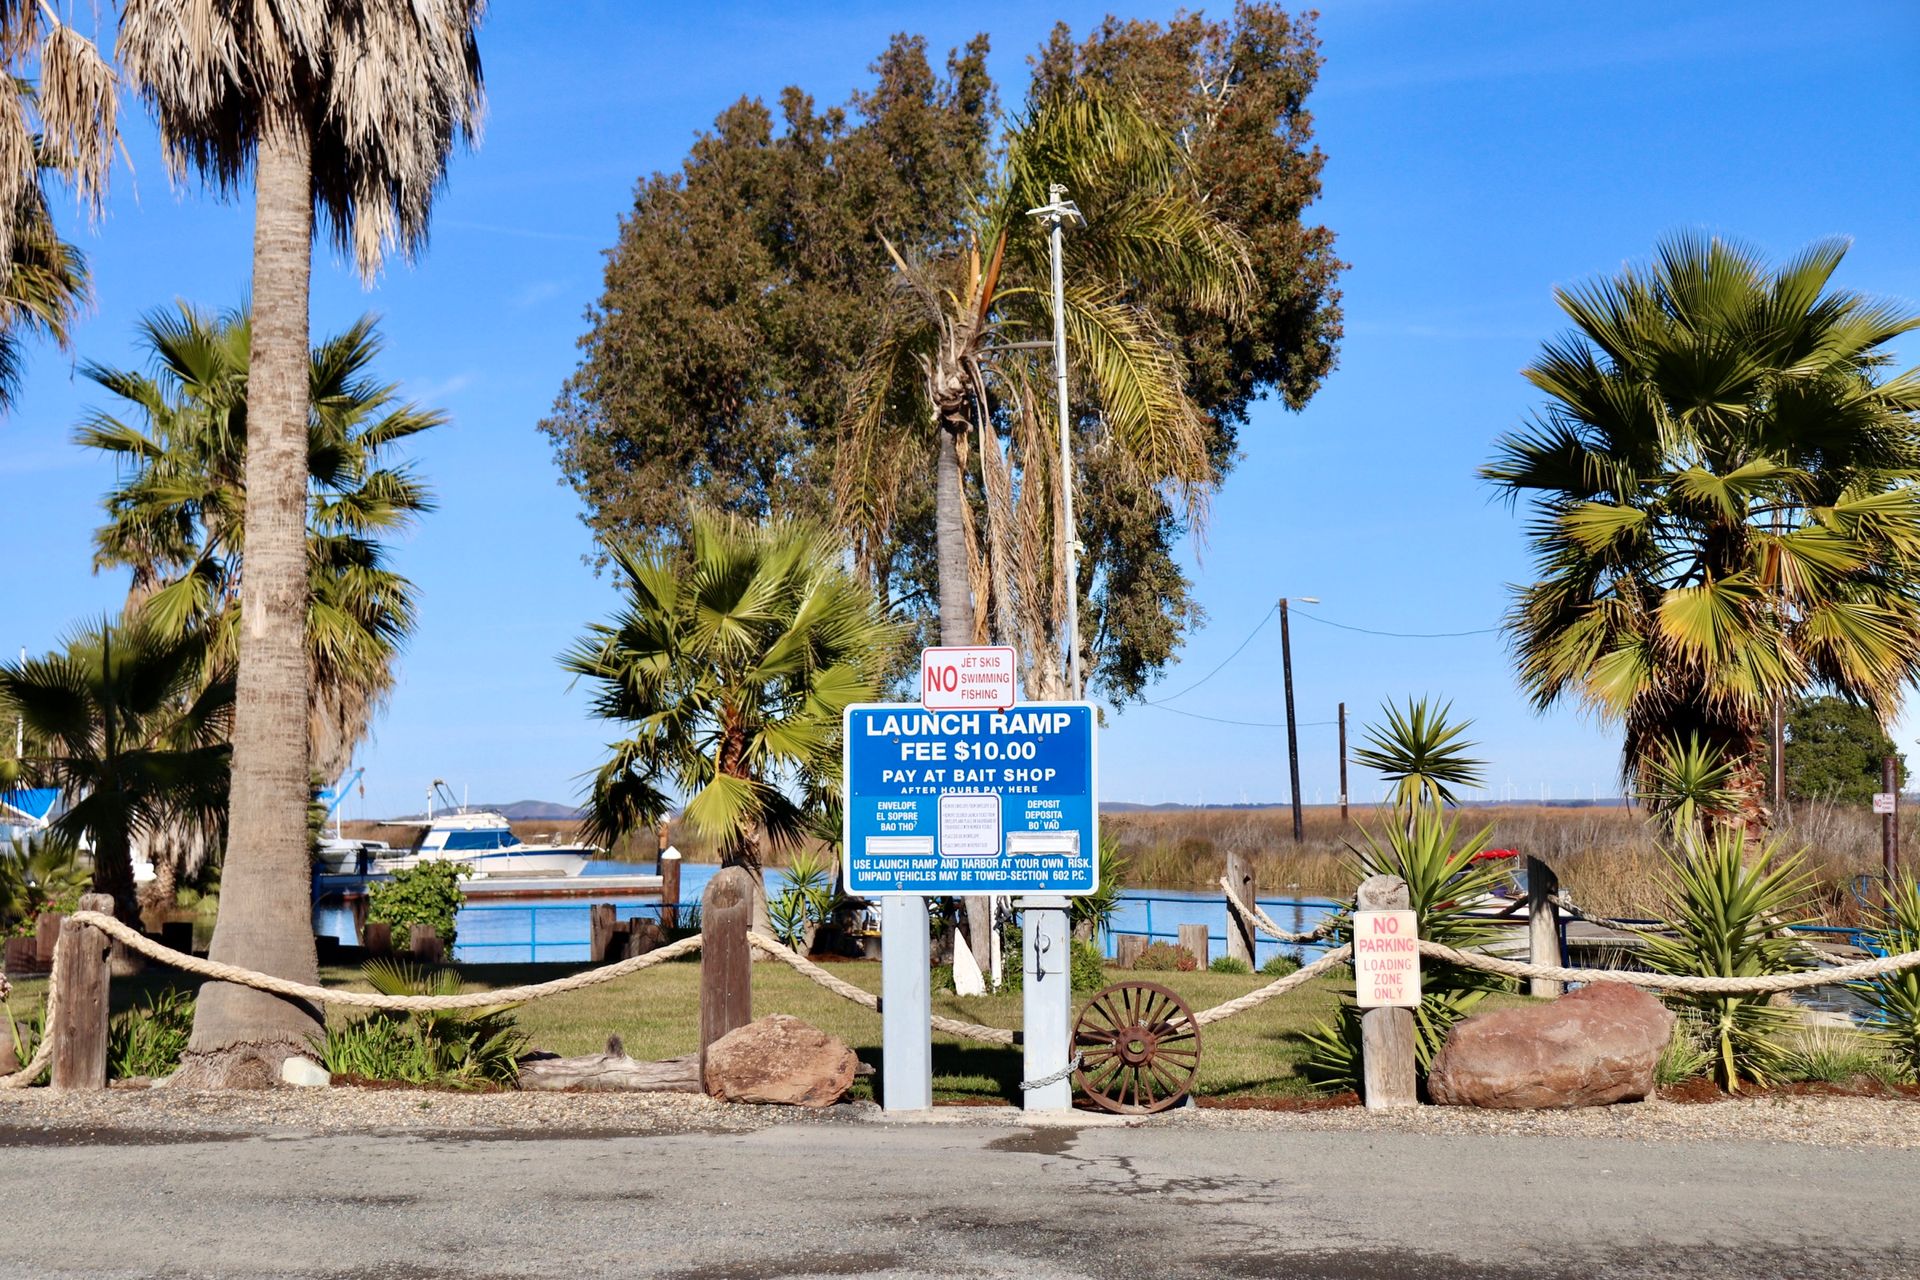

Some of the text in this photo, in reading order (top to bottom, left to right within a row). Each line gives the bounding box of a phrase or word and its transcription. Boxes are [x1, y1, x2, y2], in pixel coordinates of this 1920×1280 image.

[961, 656, 1001, 668] JET SKIS
[928, 665, 958, 693] NO
[961, 673, 1010, 684] SWIMMING
[961, 689, 998, 700] FISHING
[866, 713, 1071, 736] LAUNCH RAMP
[901, 740, 1037, 763] FEE $10.00
[882, 768, 1056, 783] PAY AT BAIT SHOP
[901, 785, 1039, 795] AFTER HOURS PAY HERE
[877, 801, 917, 810] ENVELOPE
[1027, 799, 1061, 809] DEPOSIT
[876, 811, 919, 821] EL SOPBRE
[1025, 810, 1063, 820] DEPOSITA
[880, 822, 896, 832] BAO
[853, 858, 1092, 870] USE LAUNCH RAMP AND HARBOR AT YOUR OWN RISK.
[858, 871, 891, 882] UNPAID
[894, 871, 937, 881] VEHICLES
[939, 871, 958, 881] MAY
[961, 871, 973, 881] BE
[974, 870, 1049, 881] TOWED-SECTION
[1053, 870, 1069, 881] 602
[1373, 917, 1399, 935] NO
[1359, 938, 1414, 953] PARKING
[1363, 959, 1412, 972] LOADING
[1374, 973, 1403, 986] ZONE
[1374, 987, 1404, 1000] ONLY
